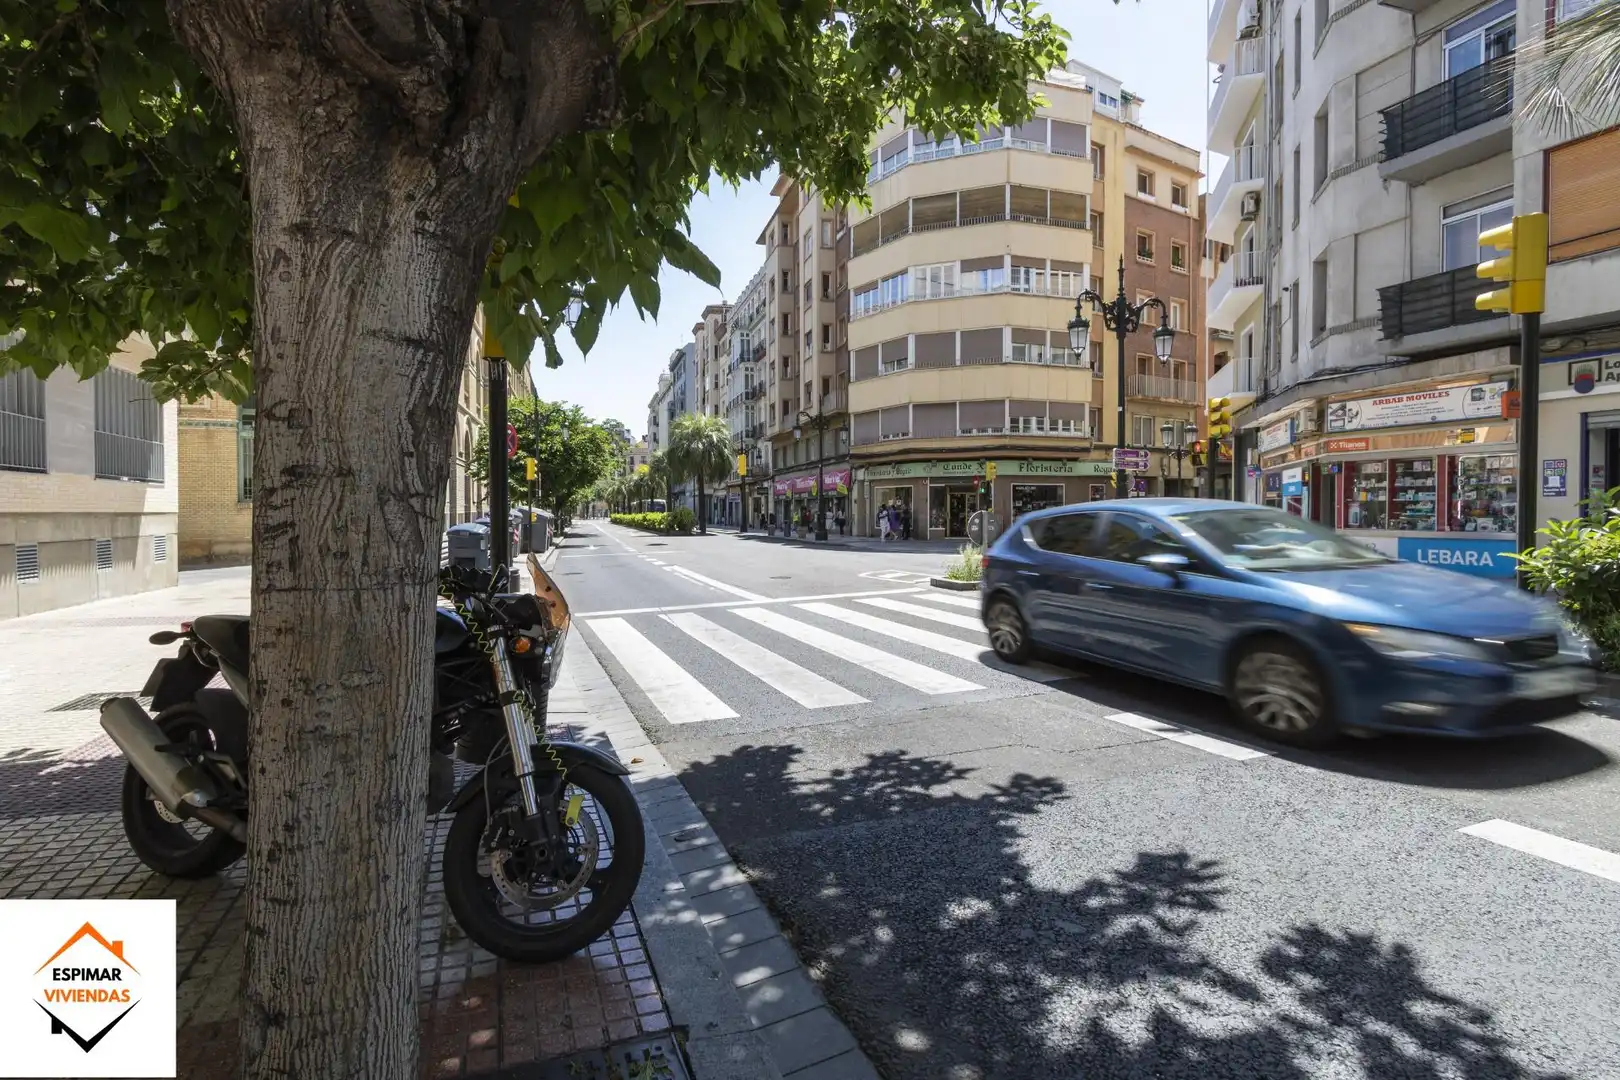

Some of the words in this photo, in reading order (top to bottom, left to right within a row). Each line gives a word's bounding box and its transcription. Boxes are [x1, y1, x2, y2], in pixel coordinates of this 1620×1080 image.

[1372, 396, 1404, 406] ARBAB
[1405, 390, 1450, 402] MOVILES
[1417, 549, 1494, 567] LEBARA
